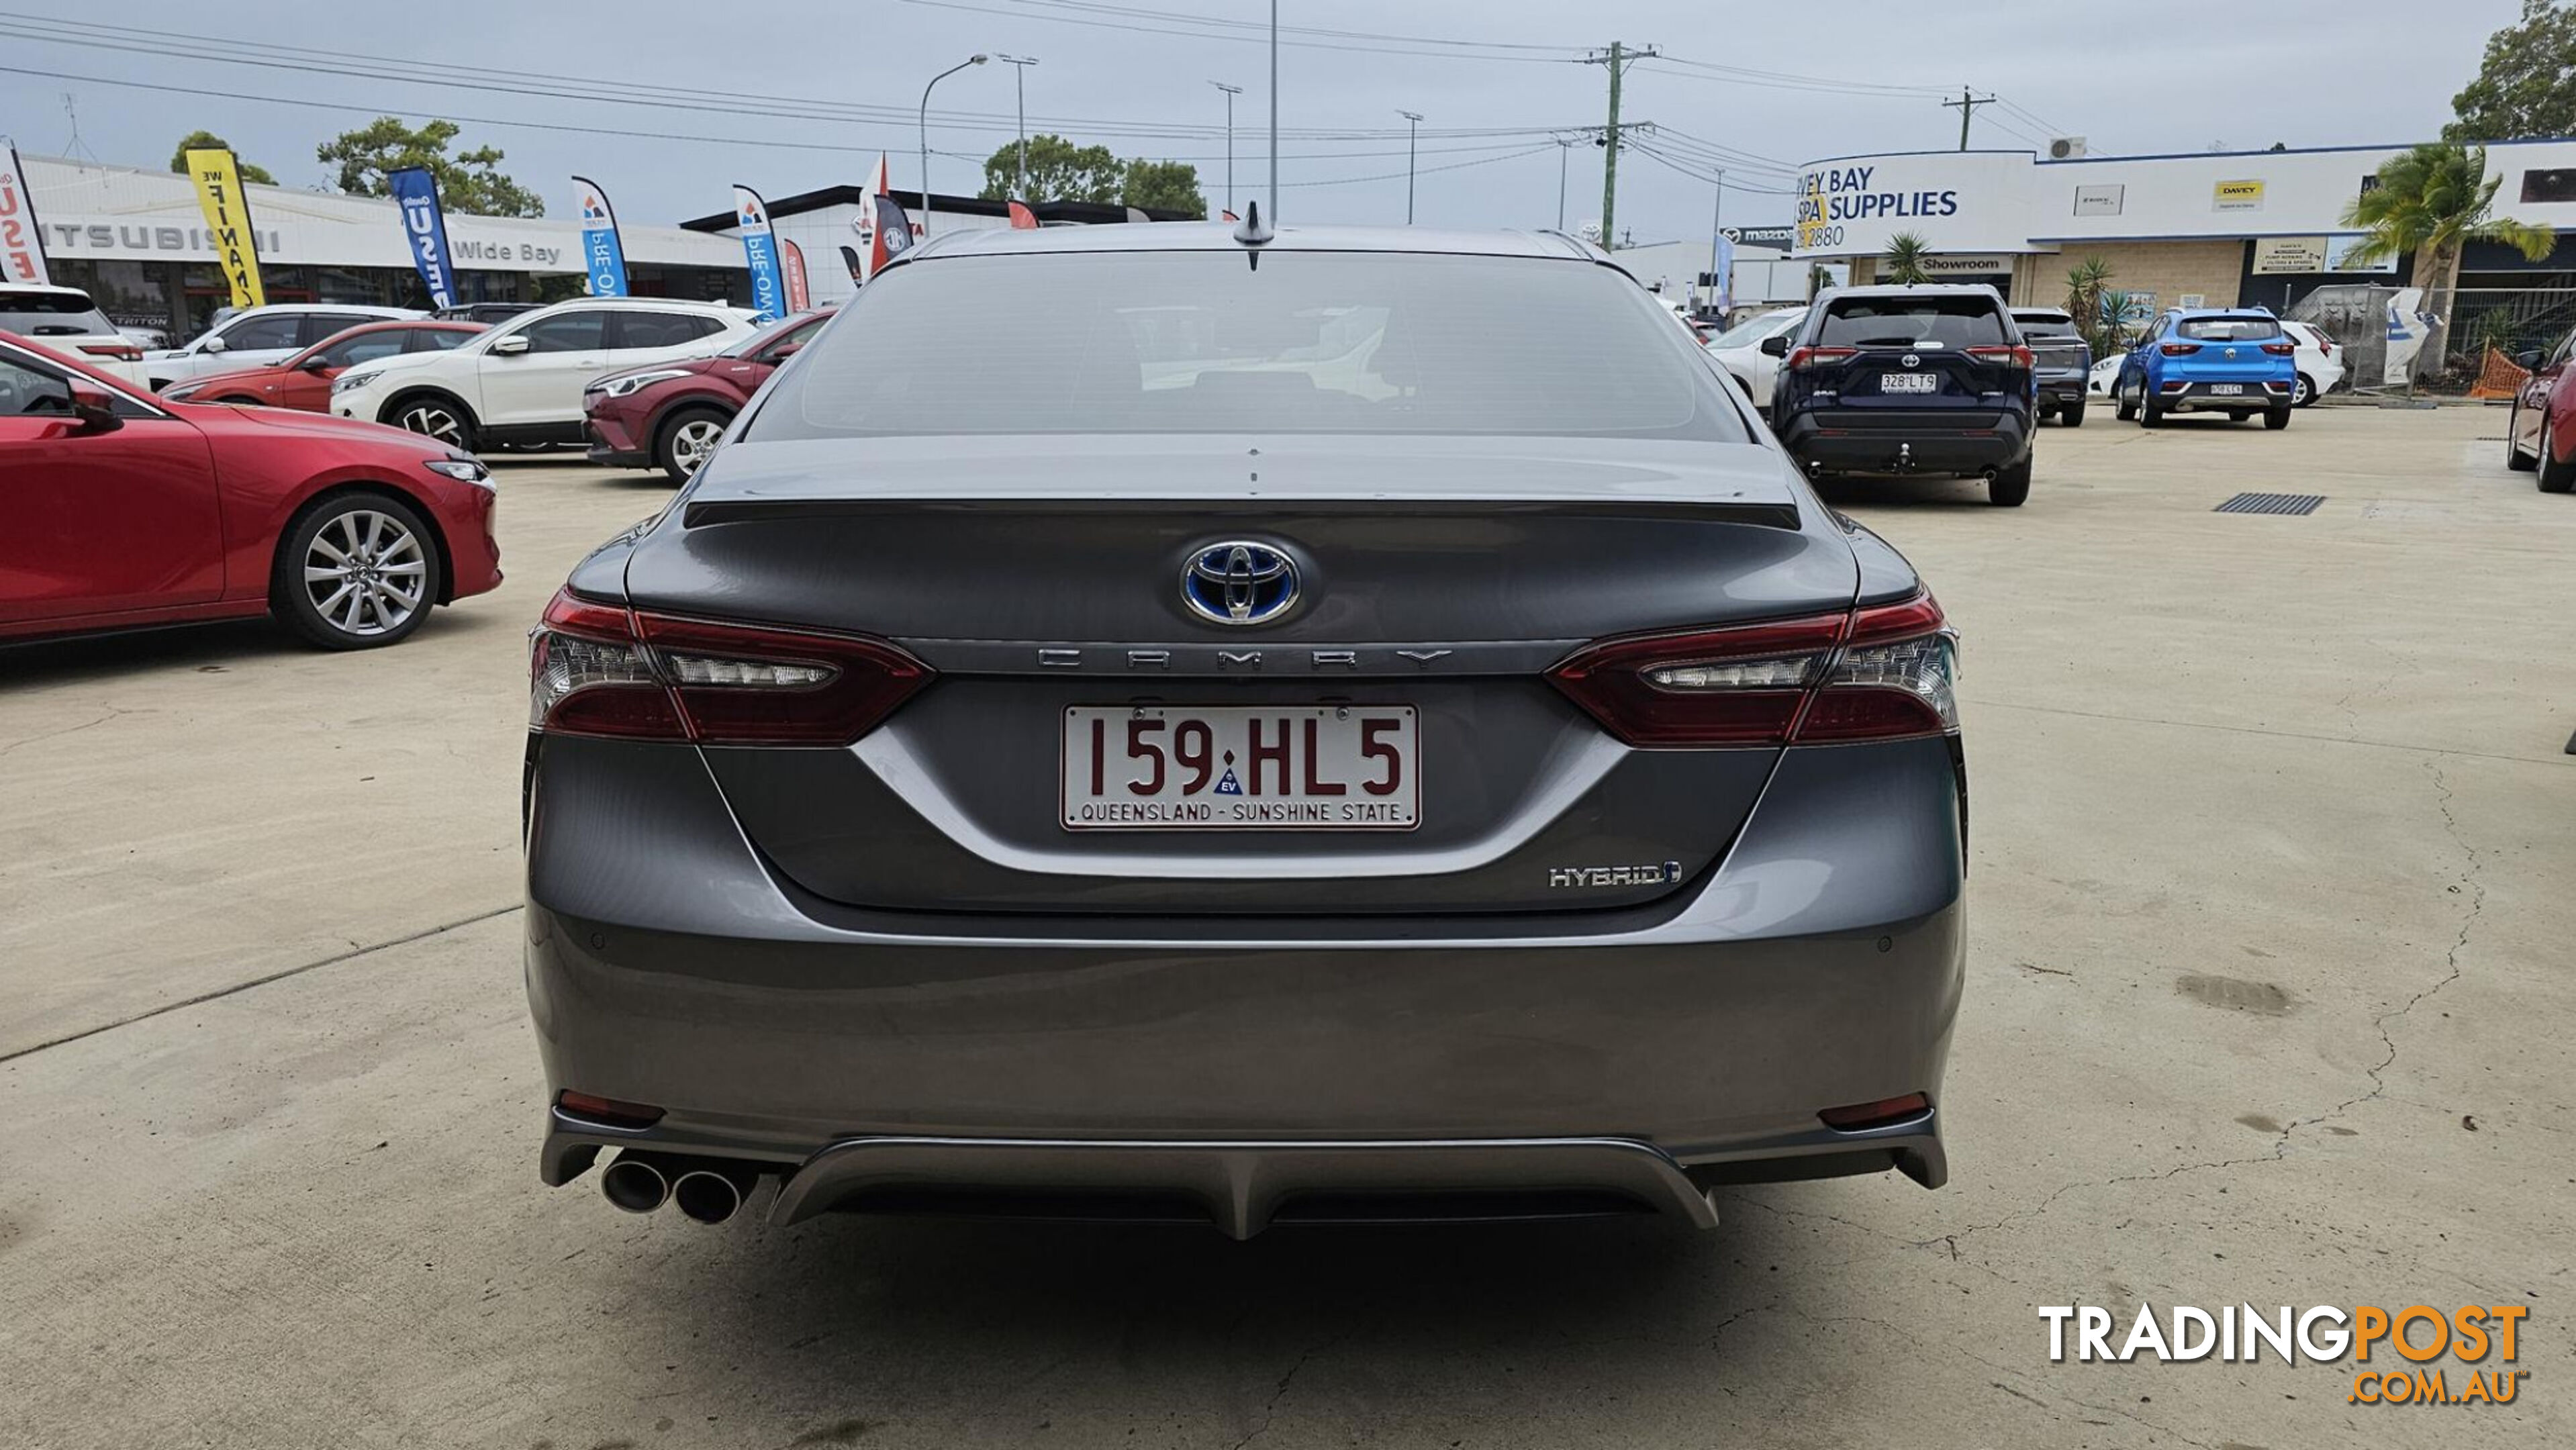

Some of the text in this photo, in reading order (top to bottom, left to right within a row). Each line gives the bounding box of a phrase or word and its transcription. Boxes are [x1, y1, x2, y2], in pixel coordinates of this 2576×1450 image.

[1829, 167, 1874, 192] BAY
[1829, 191, 1958, 220] SUPPLIES
[1808, 226, 1844, 247] 2880
[453, 242, 561, 265] Wide Bay
[1923, 258, 1999, 269] Showroom
[115, 317, 168, 326] TRITON
[1884, 375, 1905, 387] 328
[1039, 648, 1453, 667] CAMRY
[1092, 718, 1401, 796] 159 HL5
[1221, 782, 1236, 792] EV
[1081, 802, 1211, 822] QUEENSLAND
[1233, 802, 1331, 820] SUNSHINE
[1342, 802, 1400, 820] STATE
[1549, 865, 1660, 887] HYBRID
